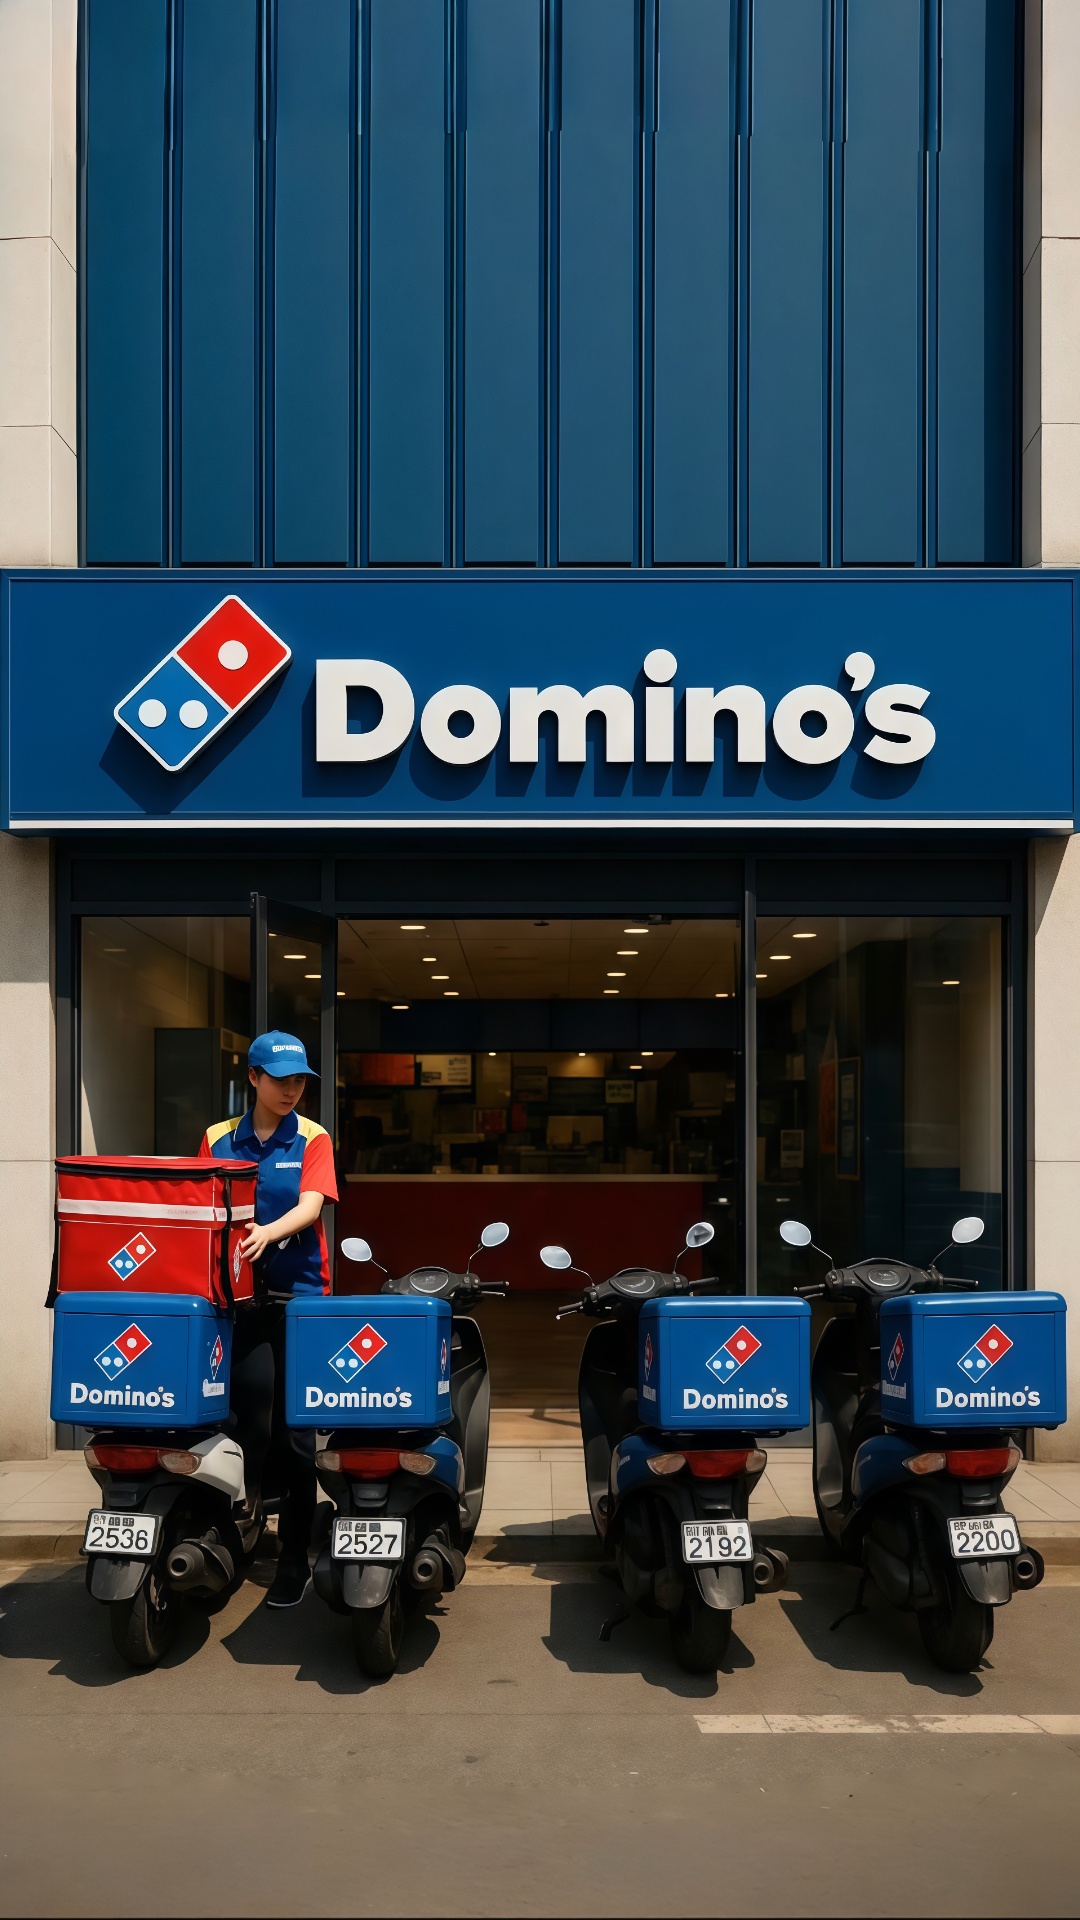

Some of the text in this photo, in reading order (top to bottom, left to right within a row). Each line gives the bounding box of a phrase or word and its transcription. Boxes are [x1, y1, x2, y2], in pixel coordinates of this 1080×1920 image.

[316, 649, 935, 764] Domino's
[70, 1383, 174, 1407] Domino's
[306, 1387, 412, 1408] Domino's
[684, 1388, 788, 1409] Domino's
[937, 1386, 1040, 1408] Domino's
[89, 1526, 148, 1550] 2536
[337, 1533, 398, 1554] 2527
[689, 1535, 747, 1558] 2192
[957, 1529, 1015, 1553] 2200
